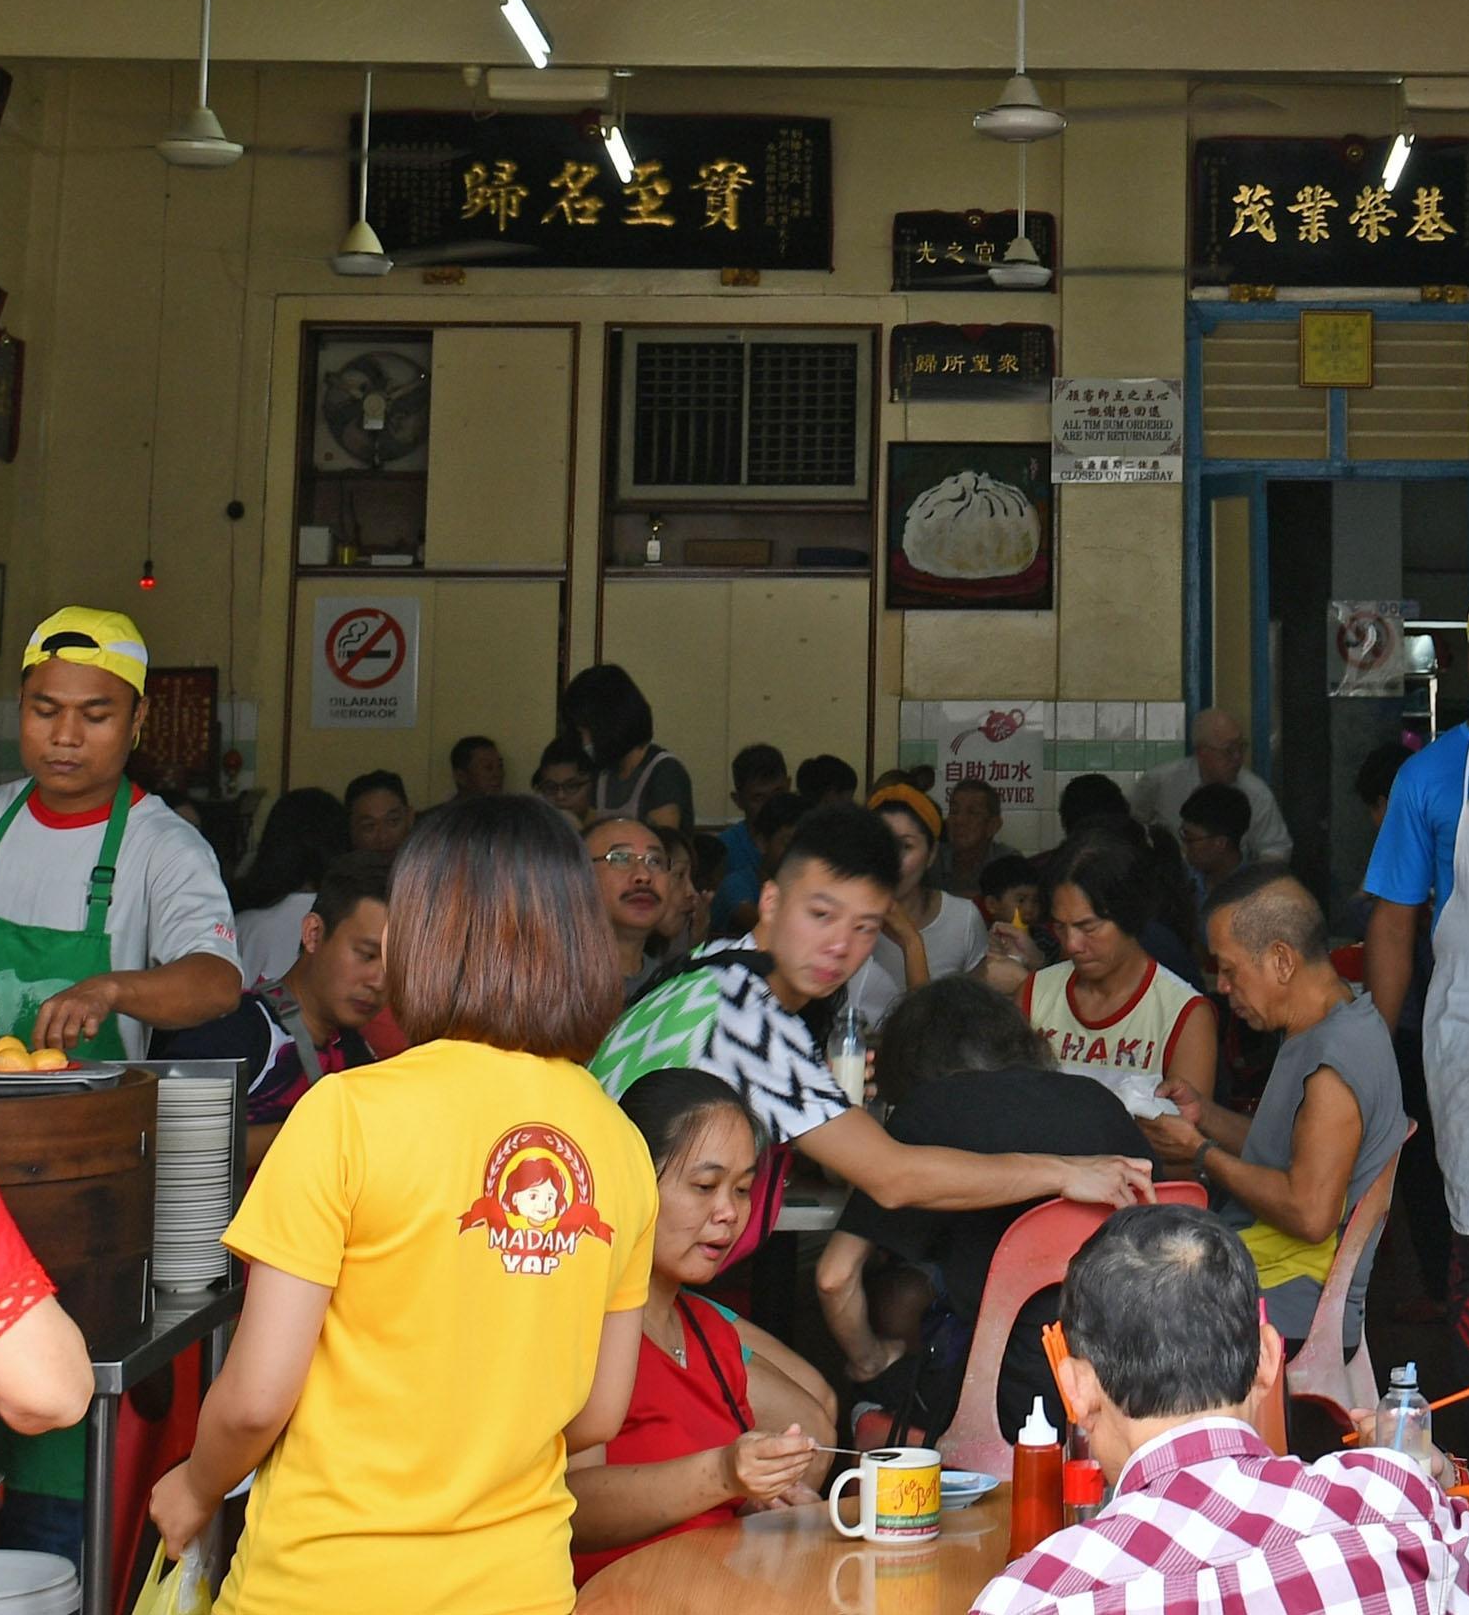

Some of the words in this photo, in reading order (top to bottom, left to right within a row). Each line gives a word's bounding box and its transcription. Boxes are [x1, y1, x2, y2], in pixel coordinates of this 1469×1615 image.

[1062, 419, 1081, 430] ALL
[1083, 419, 1101, 430] TIM
[1103, 419, 1124, 430] SUM
[1126, 419, 1174, 430] ORDERED
[1062, 431, 1083, 442] ARE
[1084, 431, 1105, 442] NOT
[1060, 471, 1103, 481] CLOSED
[1105, 471, 1122, 481] ON
[1124, 471, 1174, 481] TUESDAY
[329, 696, 398, 707] DILARANG
[329, 708, 398, 719] MEROKOK
[946, 760, 1032, 782] 自助加水
[488, 1228, 577, 1255] MADAM
[501, 1254, 560, 1275] YAP
